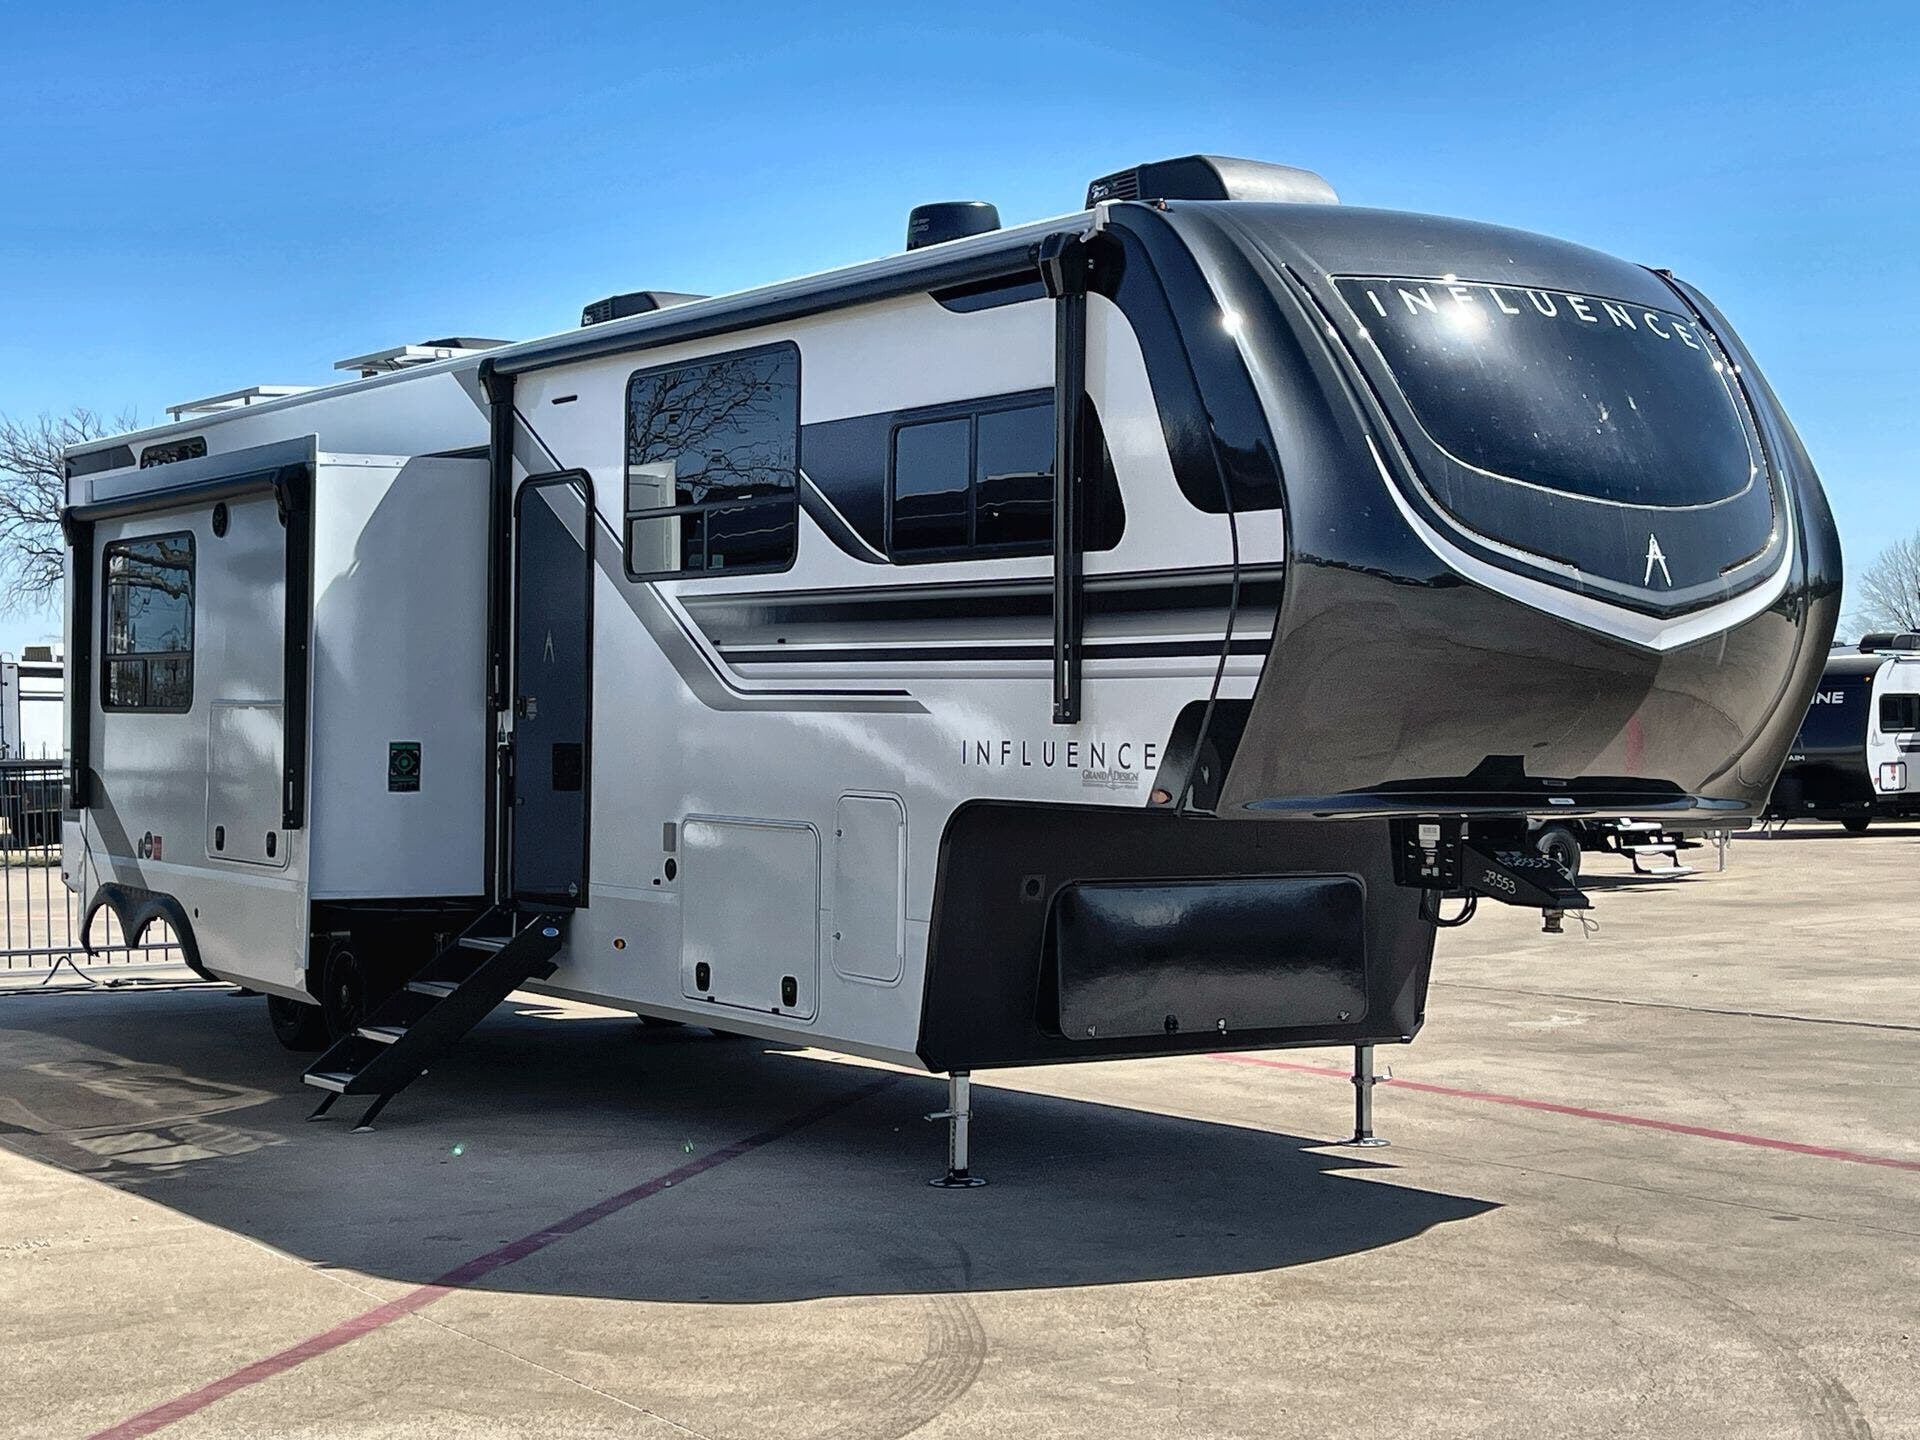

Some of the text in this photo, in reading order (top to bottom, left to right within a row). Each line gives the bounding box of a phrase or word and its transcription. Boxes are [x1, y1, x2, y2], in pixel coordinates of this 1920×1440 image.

[1366, 286, 1700, 350] INFLUENCE
[961, 739, 1156, 770] INFLUENCE
[1082, 769, 1138, 781] GRAND DESIGN
